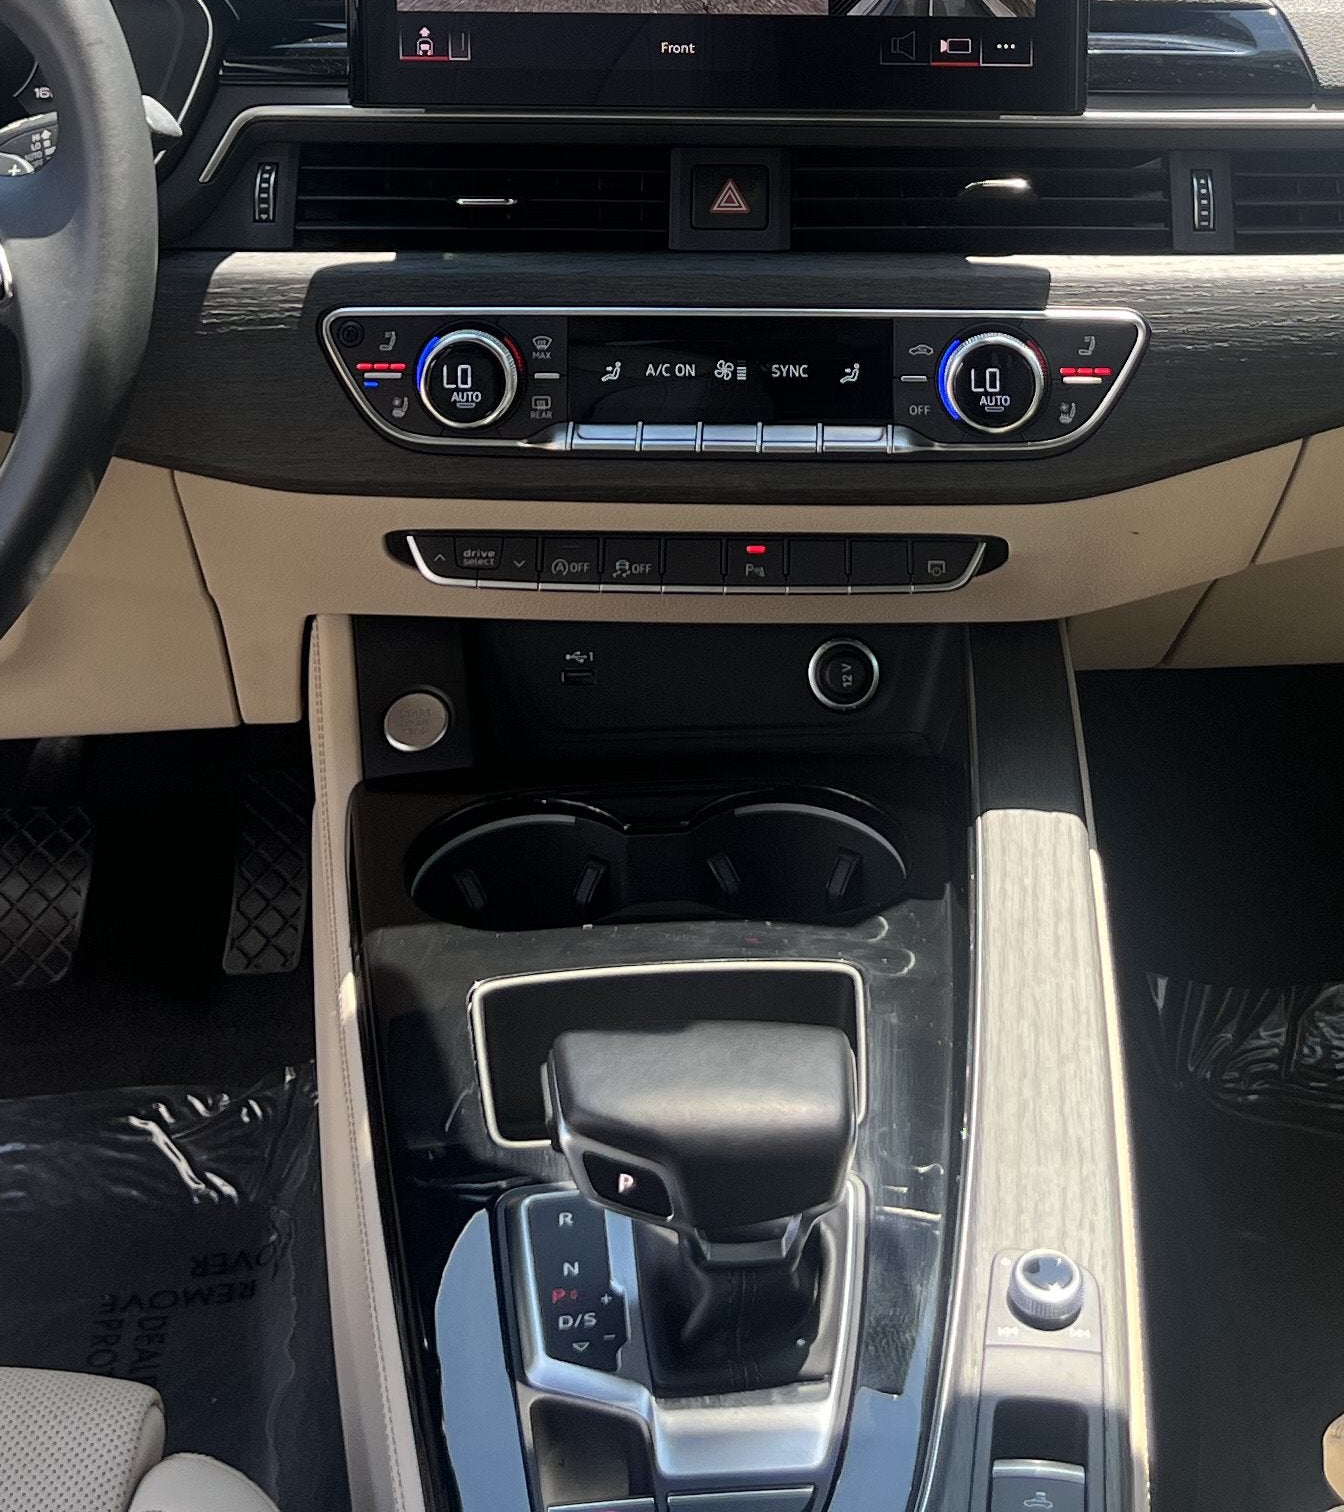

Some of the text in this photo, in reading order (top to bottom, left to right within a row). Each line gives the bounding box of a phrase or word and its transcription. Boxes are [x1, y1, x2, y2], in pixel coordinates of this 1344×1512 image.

[660, 41, 696, 56] Front
[532, 351, 552, 361] MAX
[645, 363, 697, 379] A/C ON
[770, 363, 809, 379] SYNC
[451, 391, 482, 403] AUTO
[979, 395, 1011, 408] AUTO
[530, 409, 553, 420] REAR
[908, 404, 931, 417] OFF
[462, 548, 496, 558] drive
[462, 557, 496, 567] select
[569, 562, 590, 575] OFF
[631, 563, 653, 576] OFF
[617, 1172, 635, 1194] P
[558, 1211, 574, 1227] R
[562, 1261, 580, 1277] N
[101, 1280, 258, 1312] REMOVE
[558, 1312, 598, 1330] D/S
